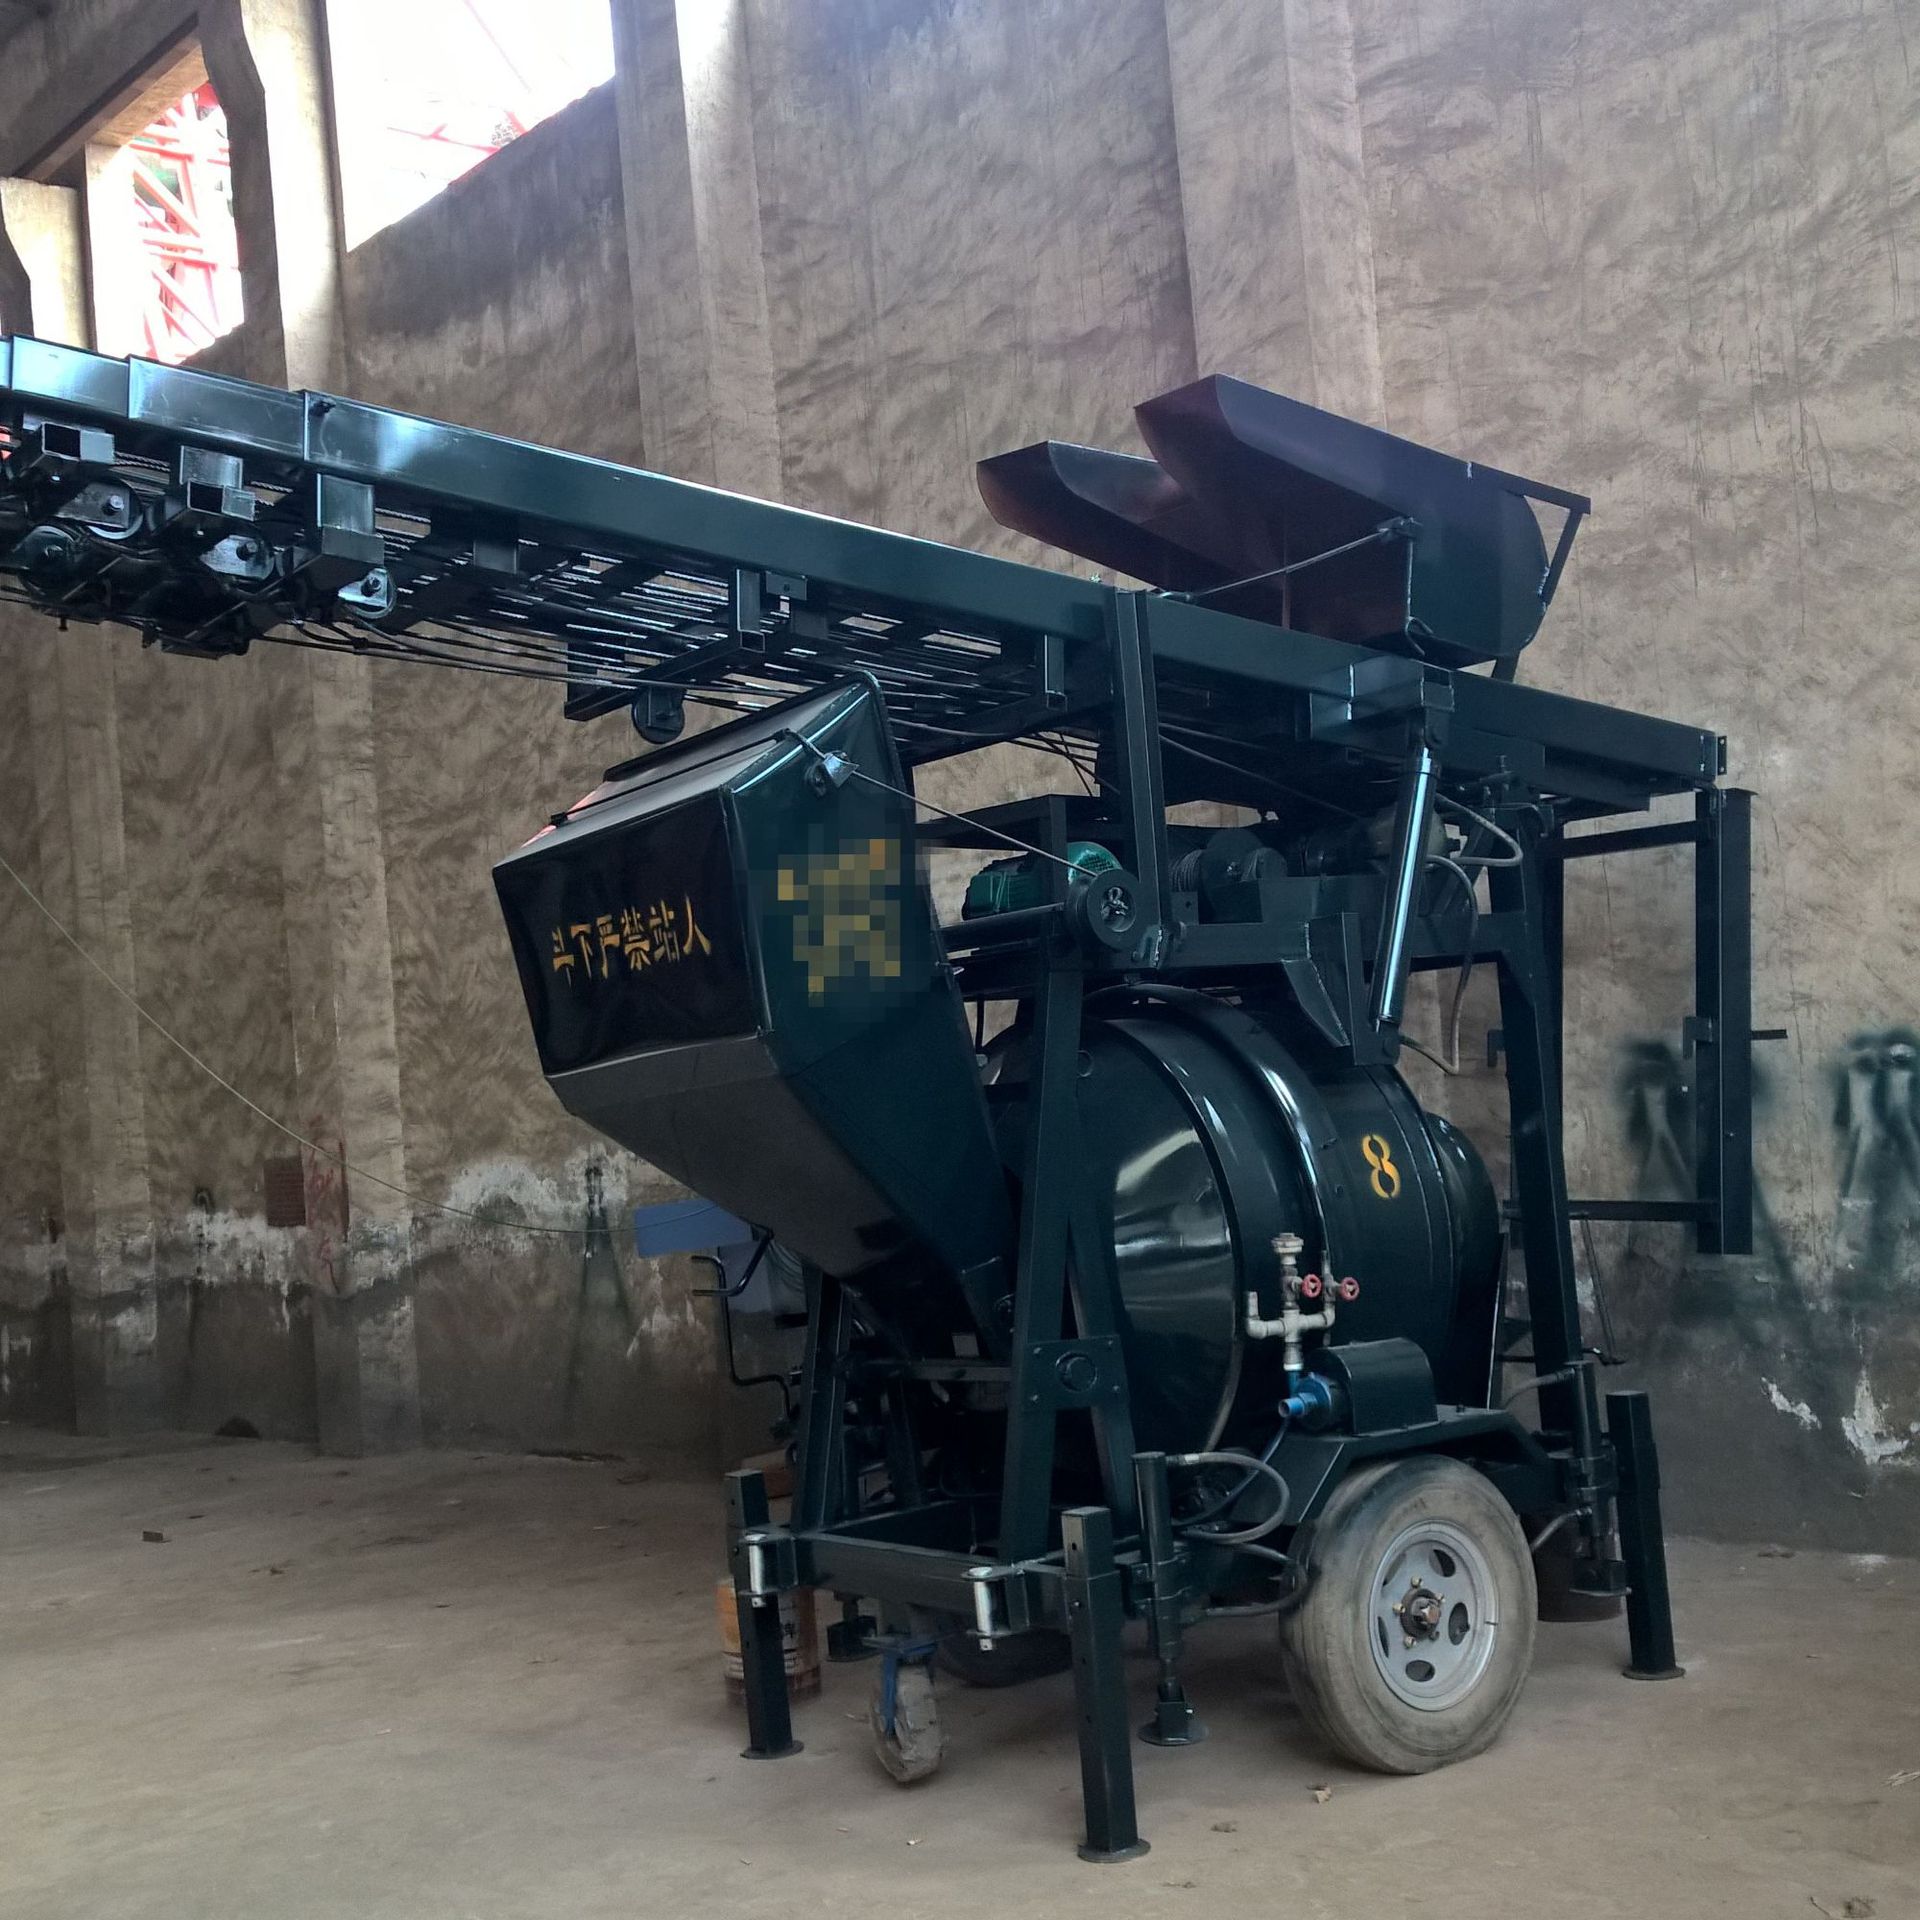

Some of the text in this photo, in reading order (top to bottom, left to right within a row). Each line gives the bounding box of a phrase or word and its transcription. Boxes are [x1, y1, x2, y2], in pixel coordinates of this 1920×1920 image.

[552, 894, 711, 988] 斗下严禁站人
[1362, 1134, 1400, 1198] 8
